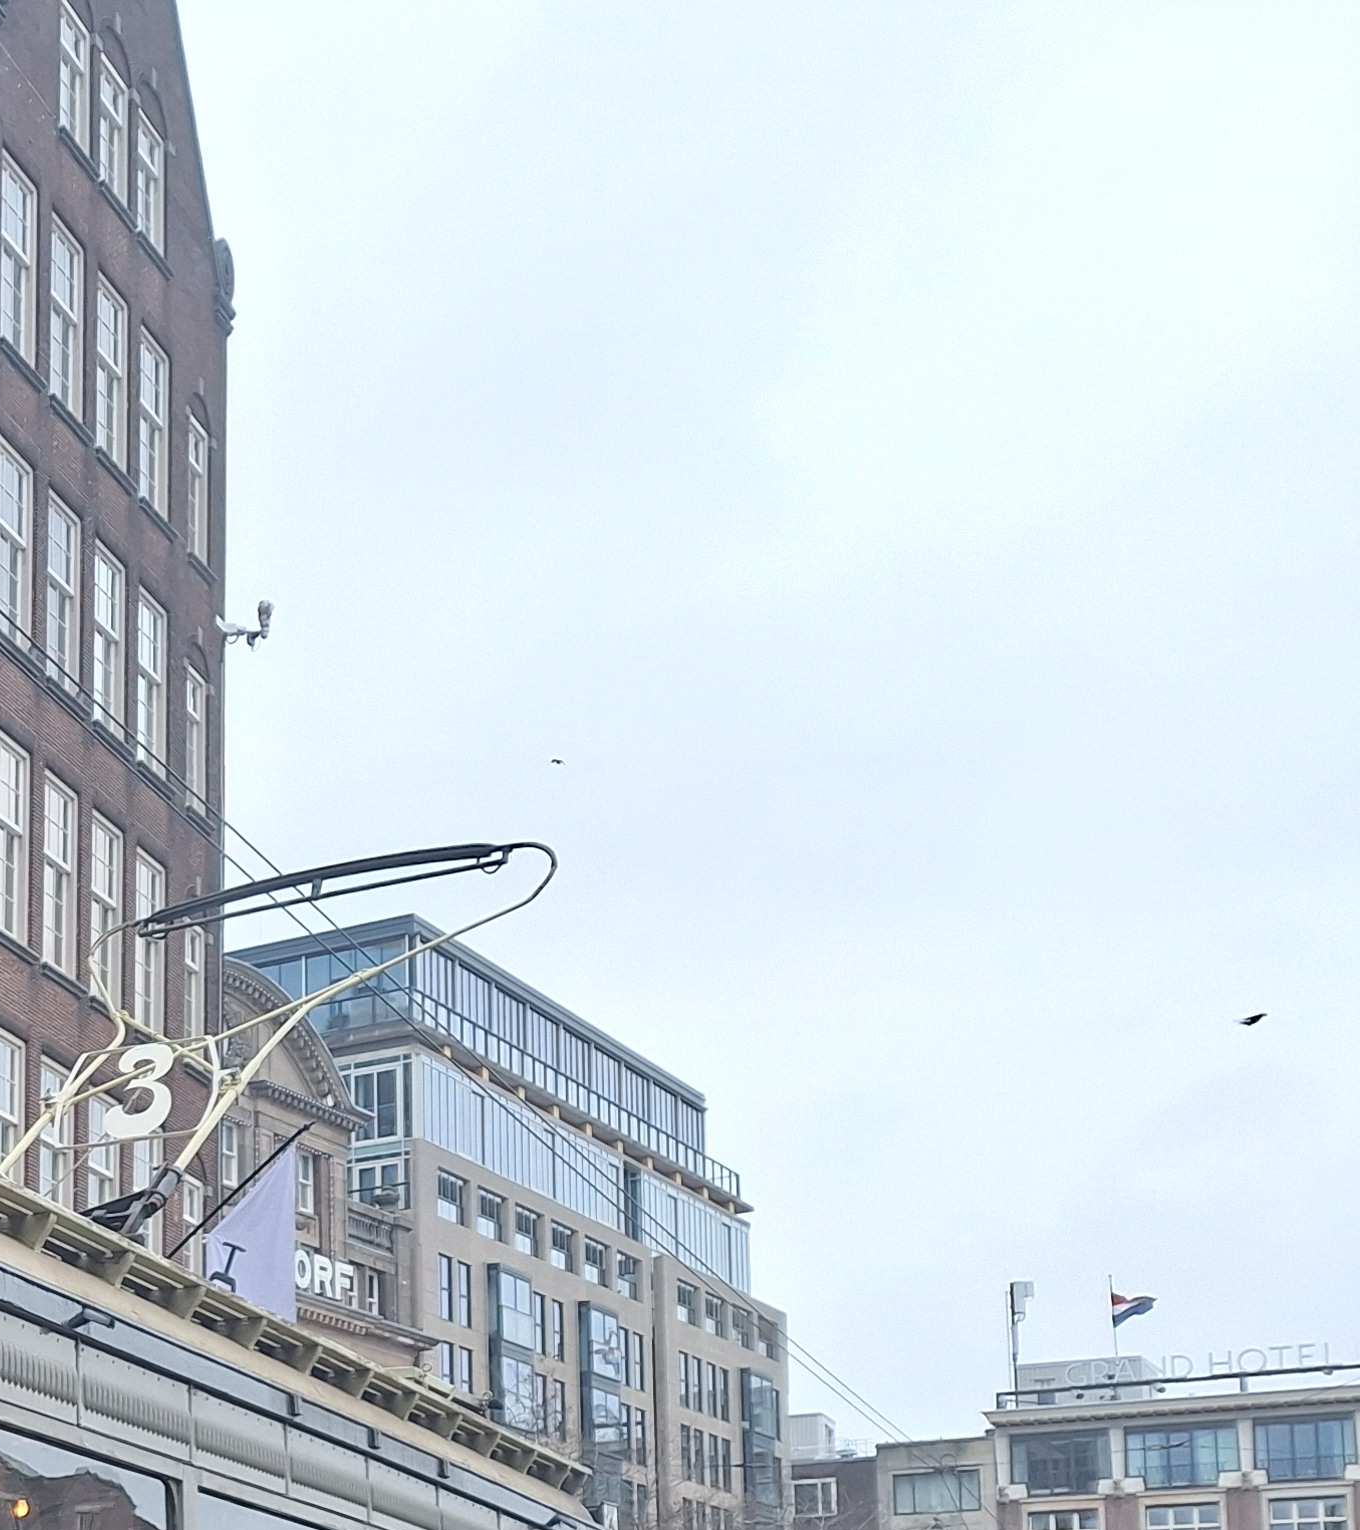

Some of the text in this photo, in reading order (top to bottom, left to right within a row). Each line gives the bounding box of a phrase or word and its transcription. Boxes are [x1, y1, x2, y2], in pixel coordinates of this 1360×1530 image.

[105, 1043, 174, 1138] 3
[294, 1249, 354, 1300] ORF
[1064, 1342, 1344, 1387] GRAND HOTEL
